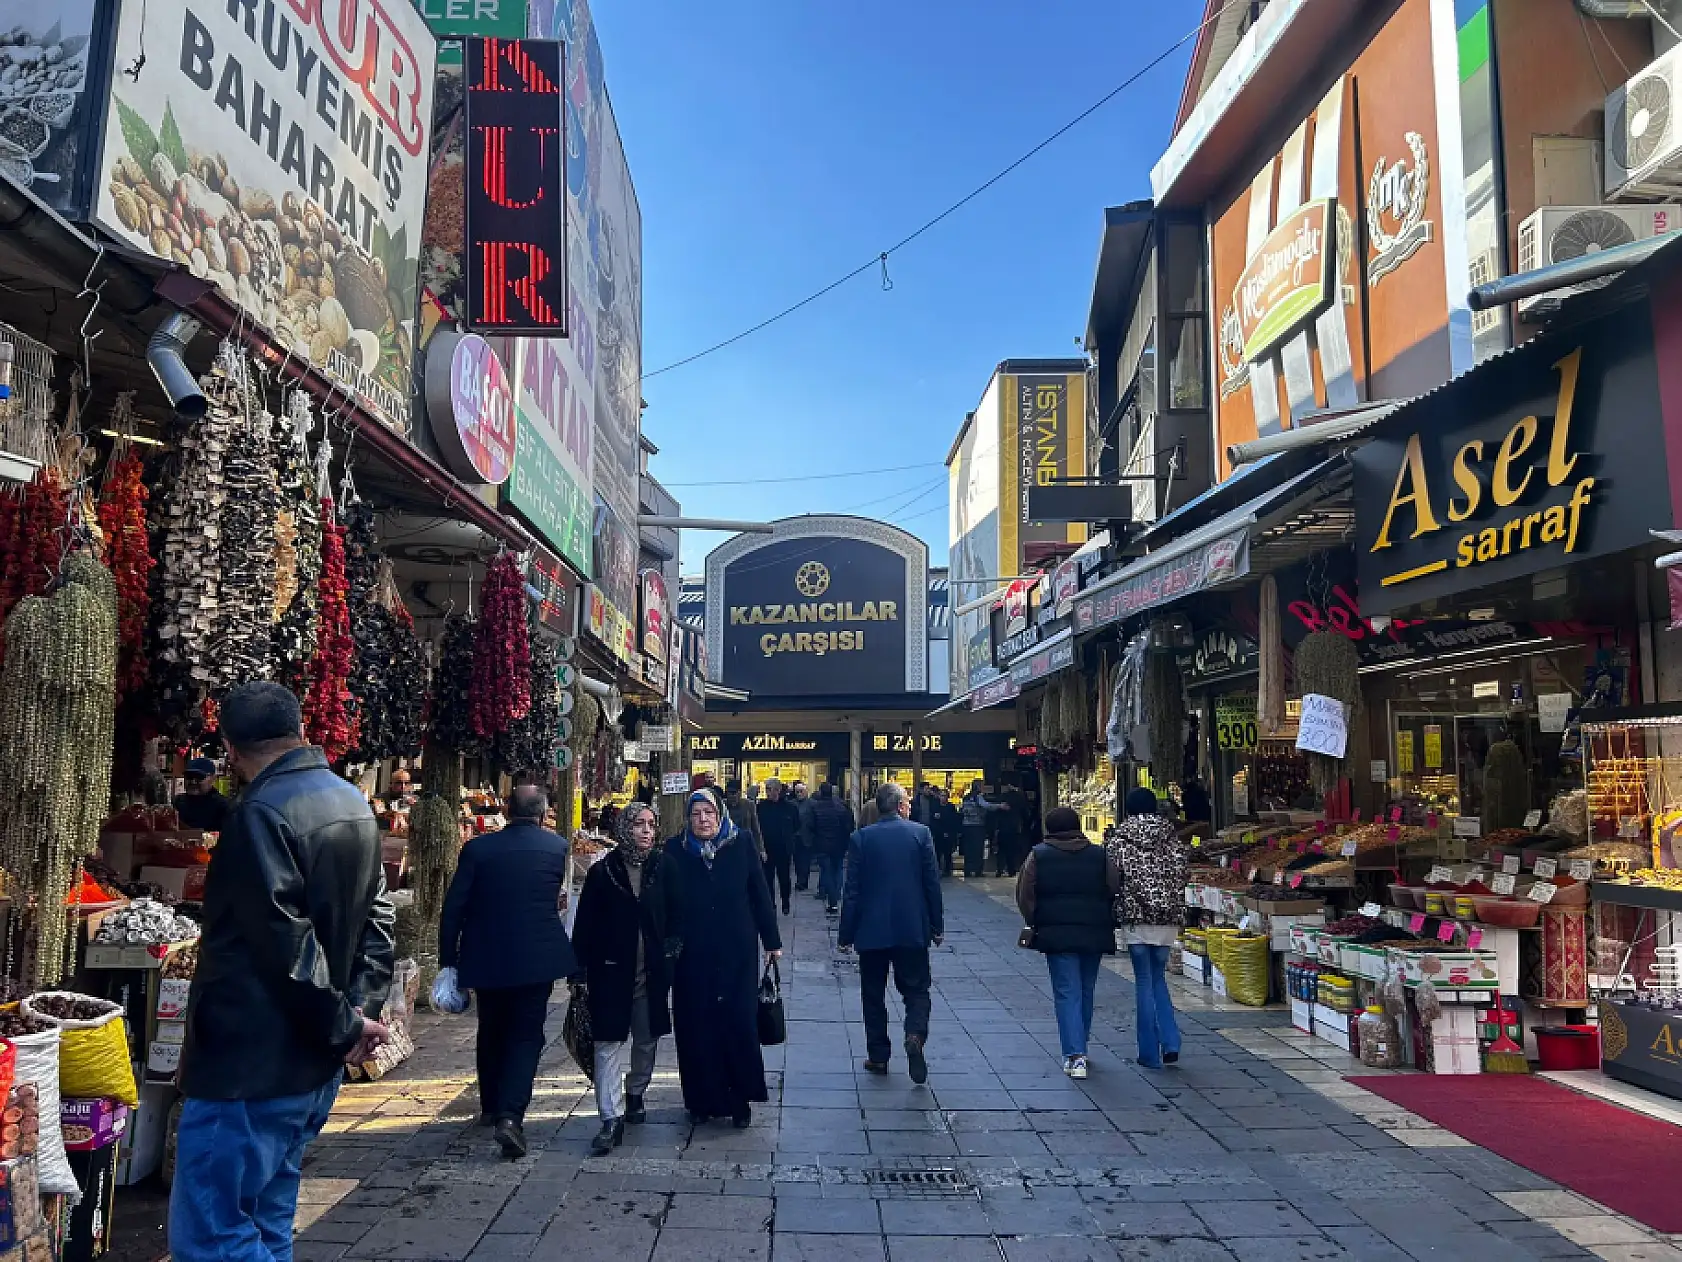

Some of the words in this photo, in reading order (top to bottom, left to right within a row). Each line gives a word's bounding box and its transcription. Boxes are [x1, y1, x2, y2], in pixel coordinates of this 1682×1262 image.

[287, 0, 423, 157] UR
[180, 7, 378, 257] BAHARAT
[1037, 384, 1062, 487] İSTANB
[1370, 346, 1582, 552] Asel
[1456, 477, 1595, 568] sarraf
[730, 601, 898, 625] KAZANCILAR
[760, 631, 864, 657] ÇARŞISI
[741, 733, 785, 750] AZİM
[1219, 722, 1258, 748] 390
[1648, 1024, 1682, 1058] A
